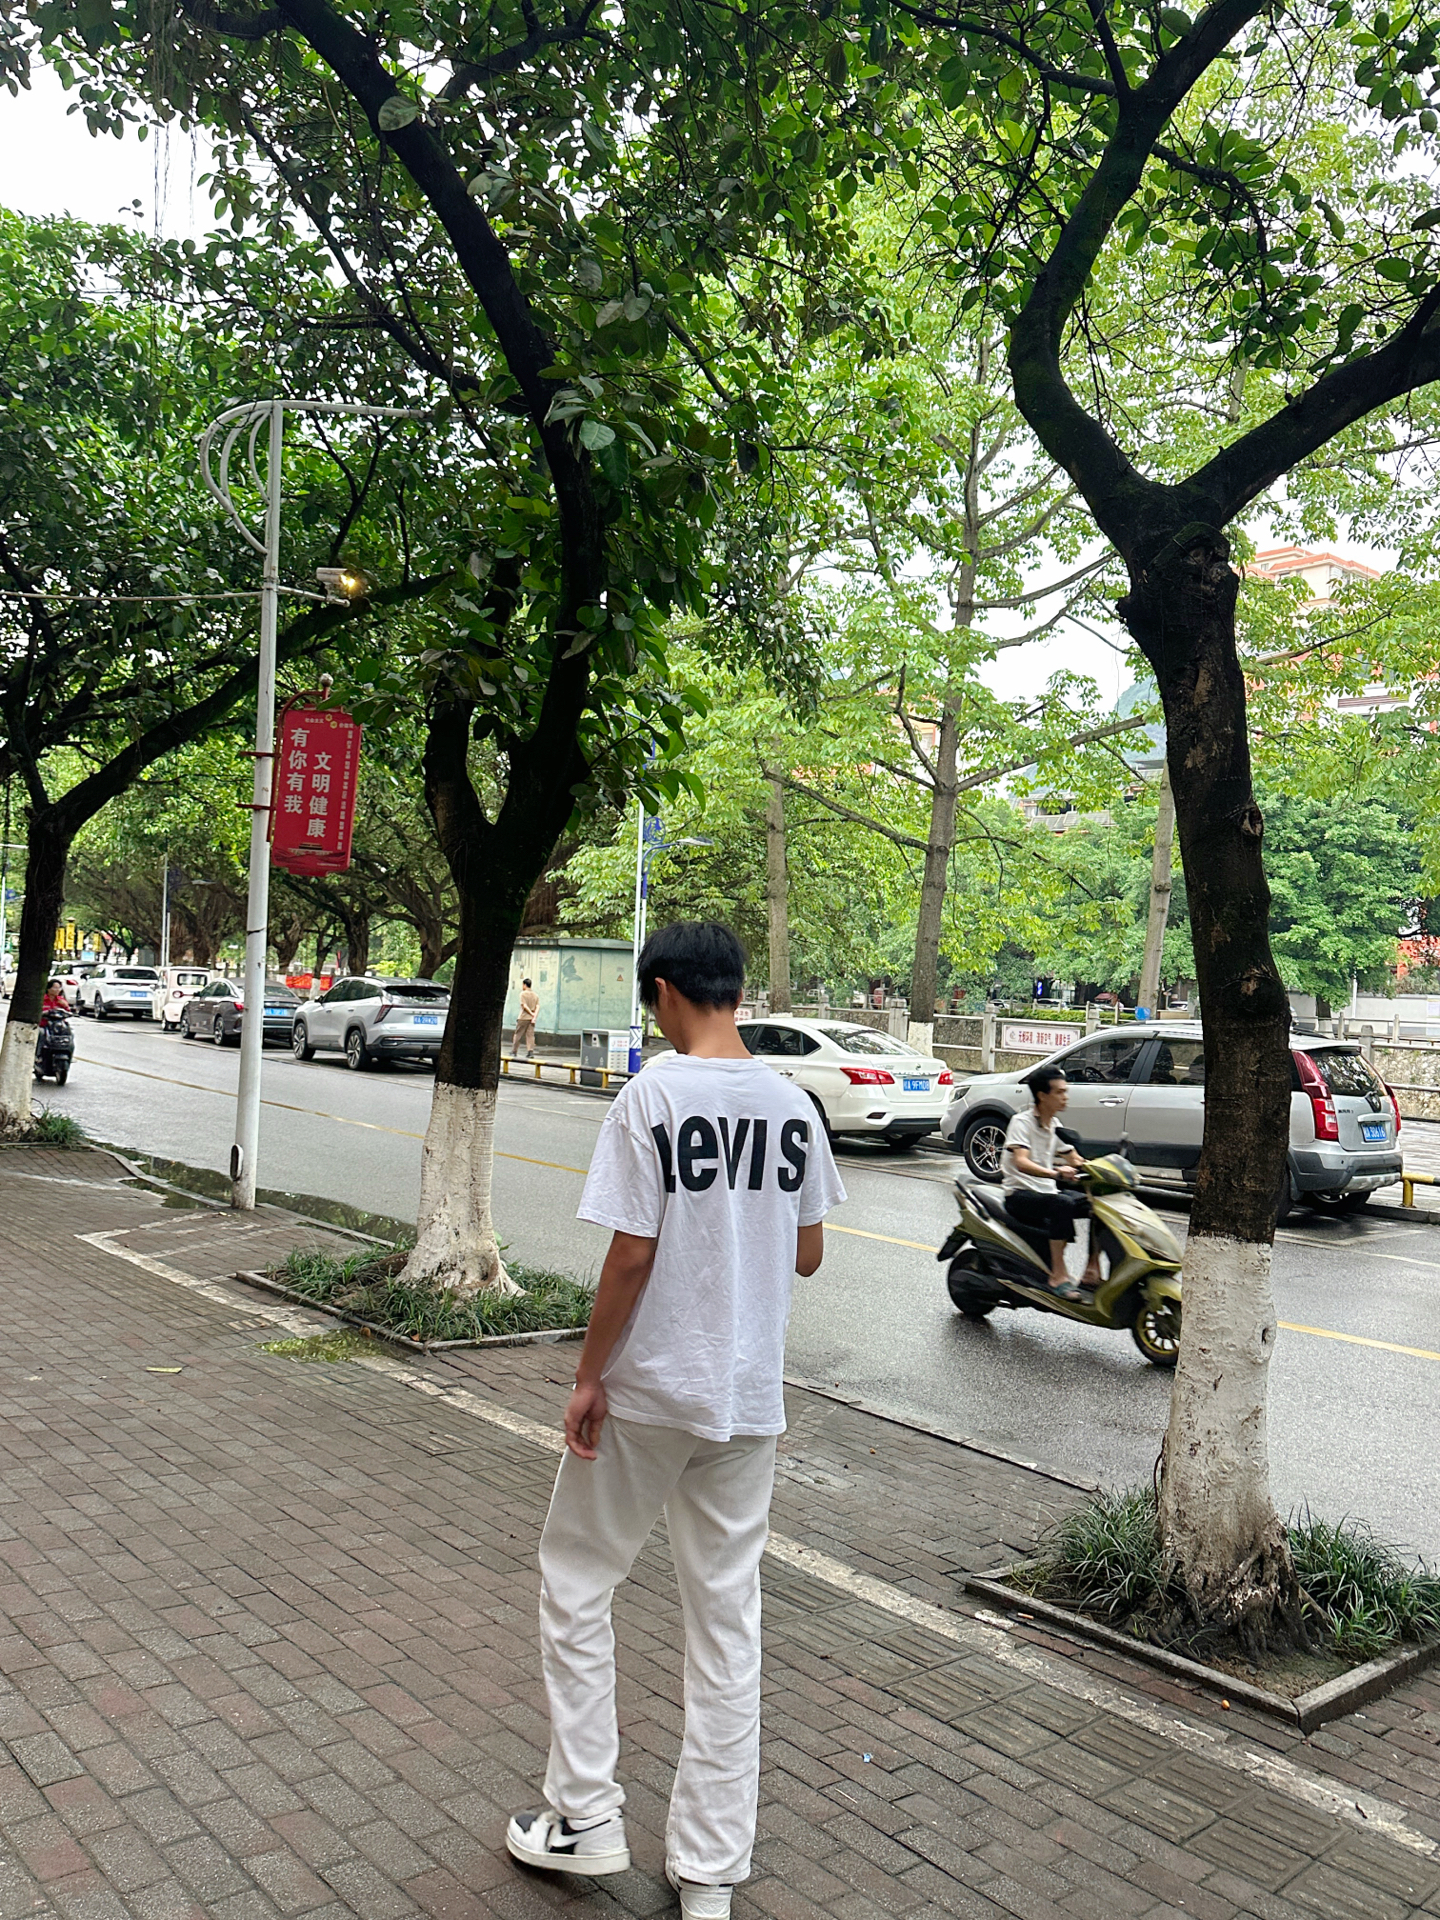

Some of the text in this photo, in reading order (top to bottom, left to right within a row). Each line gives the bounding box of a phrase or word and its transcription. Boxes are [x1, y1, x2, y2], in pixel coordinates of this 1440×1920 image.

[284, 728, 310, 814] 有你有我
[307, 751, 332, 838] 文明健康
